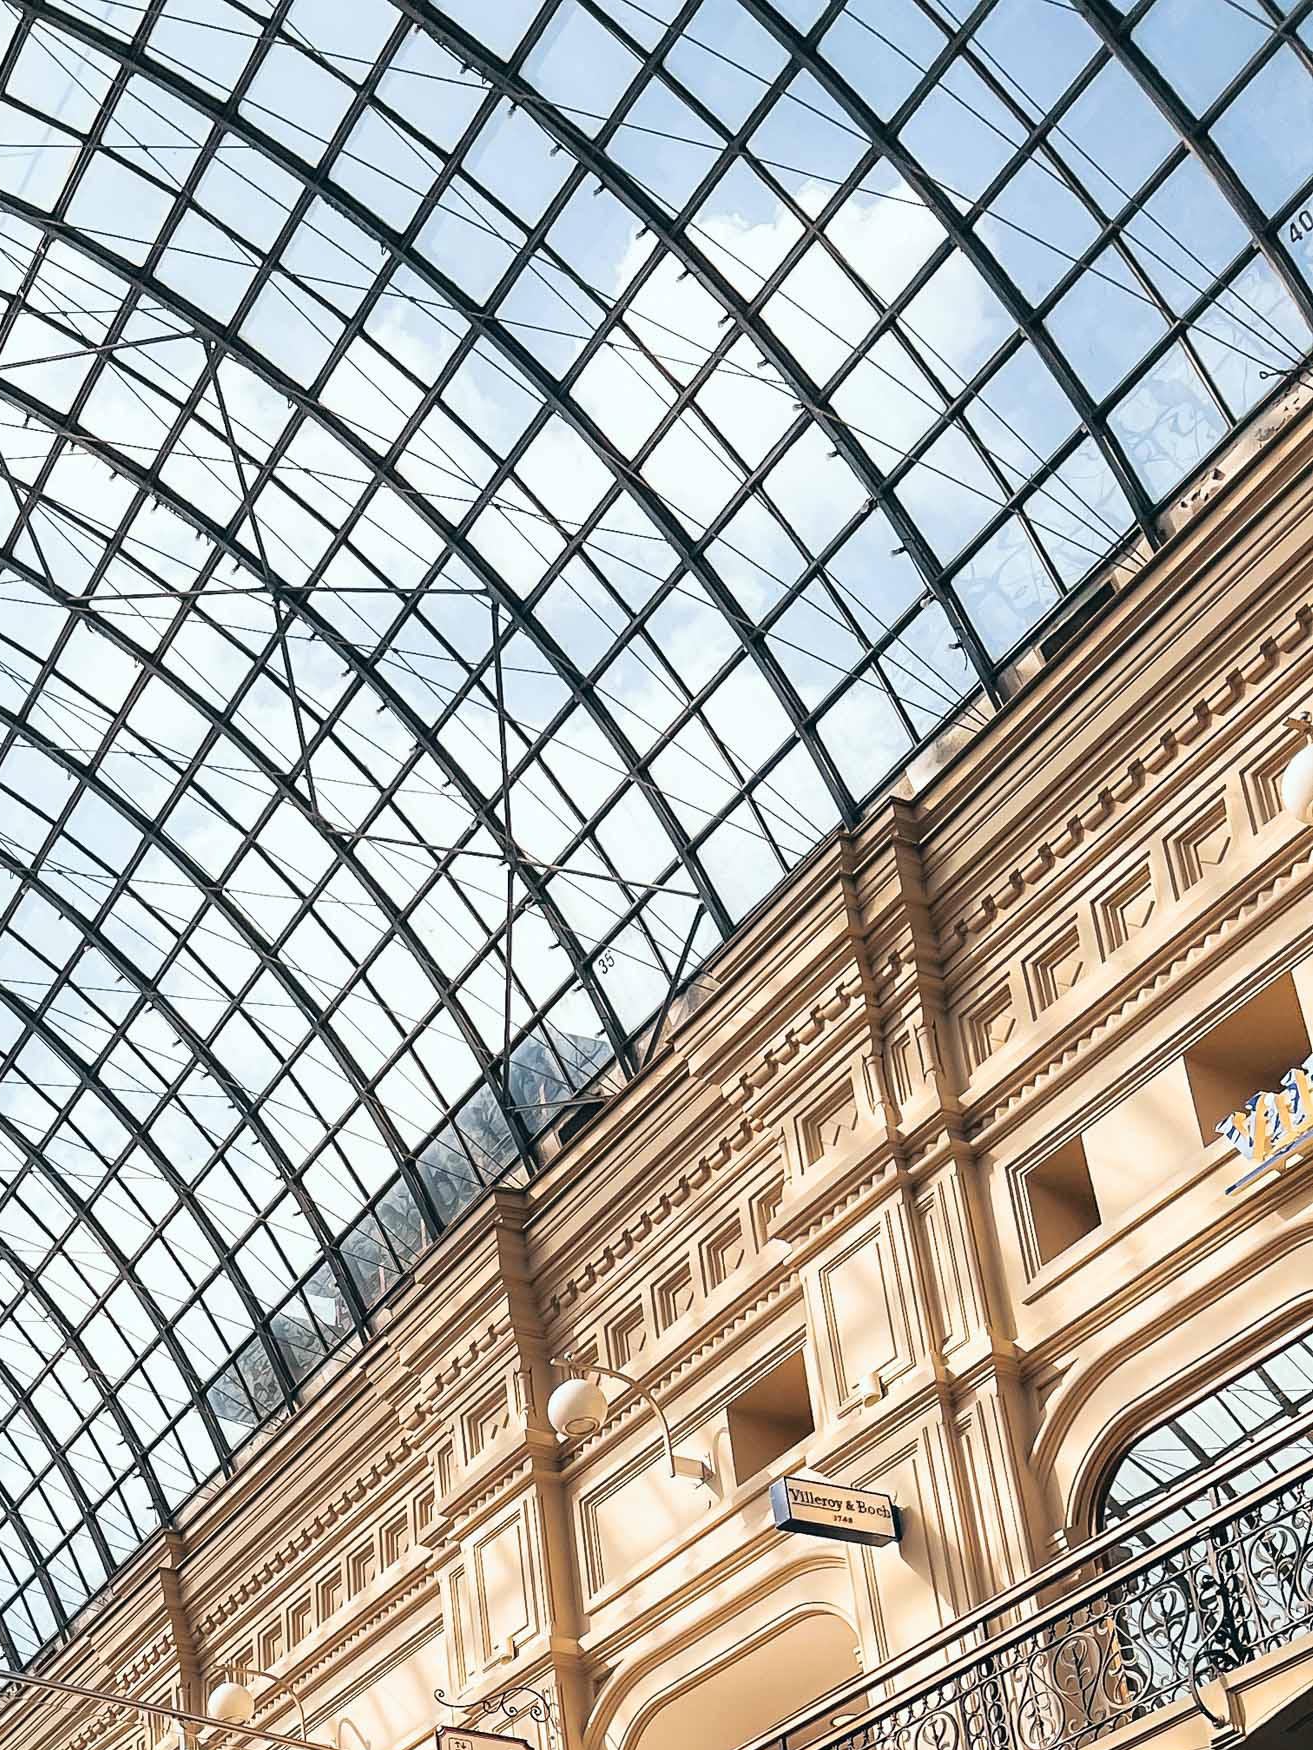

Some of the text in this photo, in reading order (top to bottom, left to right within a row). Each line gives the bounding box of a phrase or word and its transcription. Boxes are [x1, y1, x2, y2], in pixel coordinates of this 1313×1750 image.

[788, 1487, 891, 1519] Villeroy & Boch
